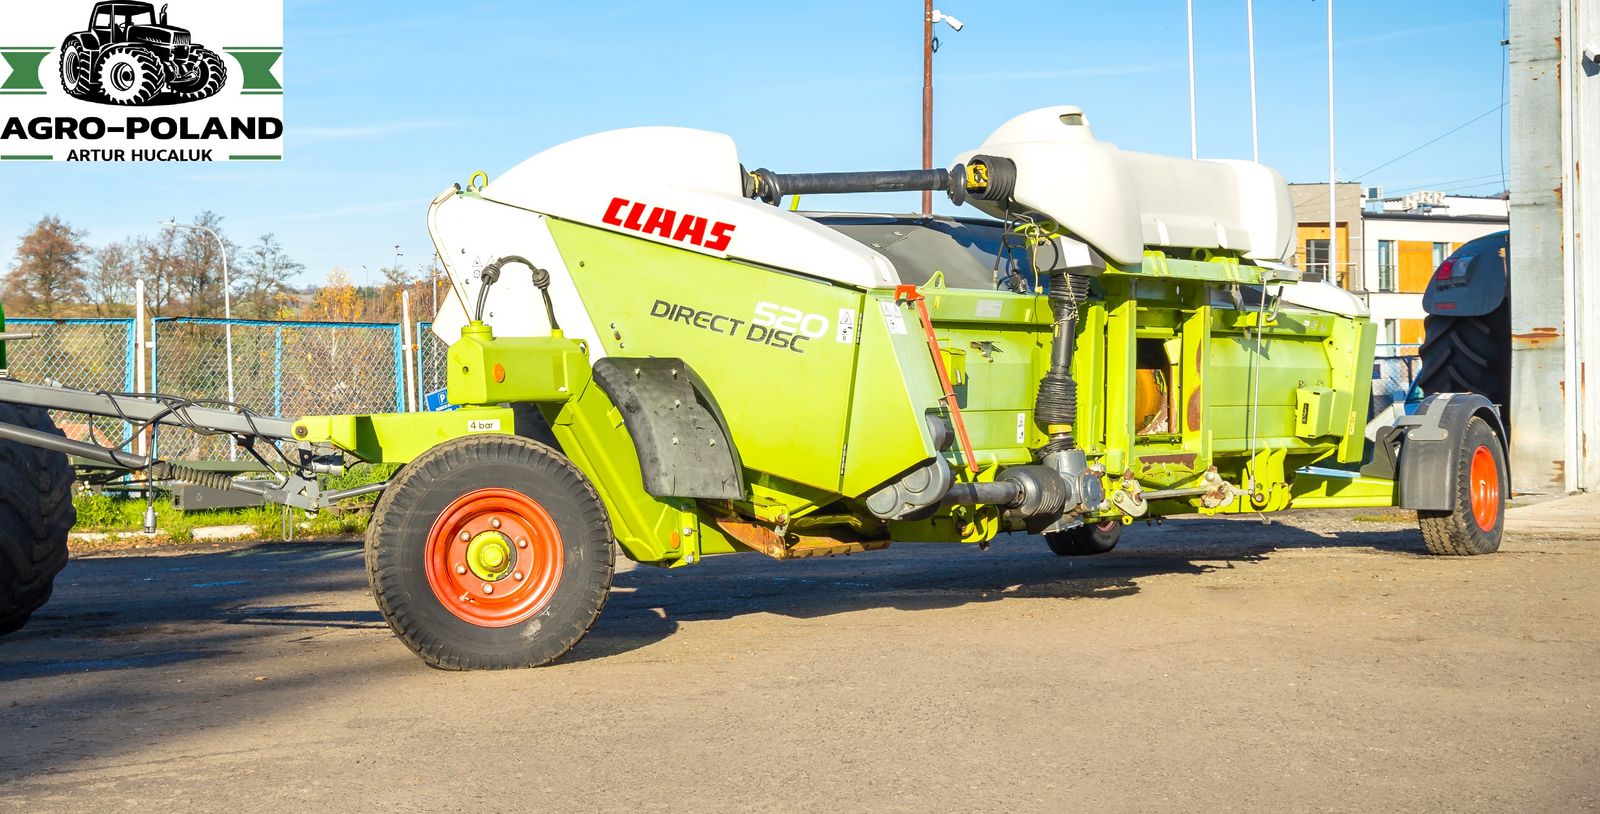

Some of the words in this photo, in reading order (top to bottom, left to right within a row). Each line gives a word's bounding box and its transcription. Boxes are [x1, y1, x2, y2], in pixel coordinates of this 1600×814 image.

[602, 197, 736, 251] CLAAS
[650, 299, 745, 336] DIRECT
[746, 323, 810, 354] DISC
[752, 301, 829, 339] 520
[439, 394, 446, 403] P
[470, 421, 477, 430] 4
[479, 421, 494, 430] bar
